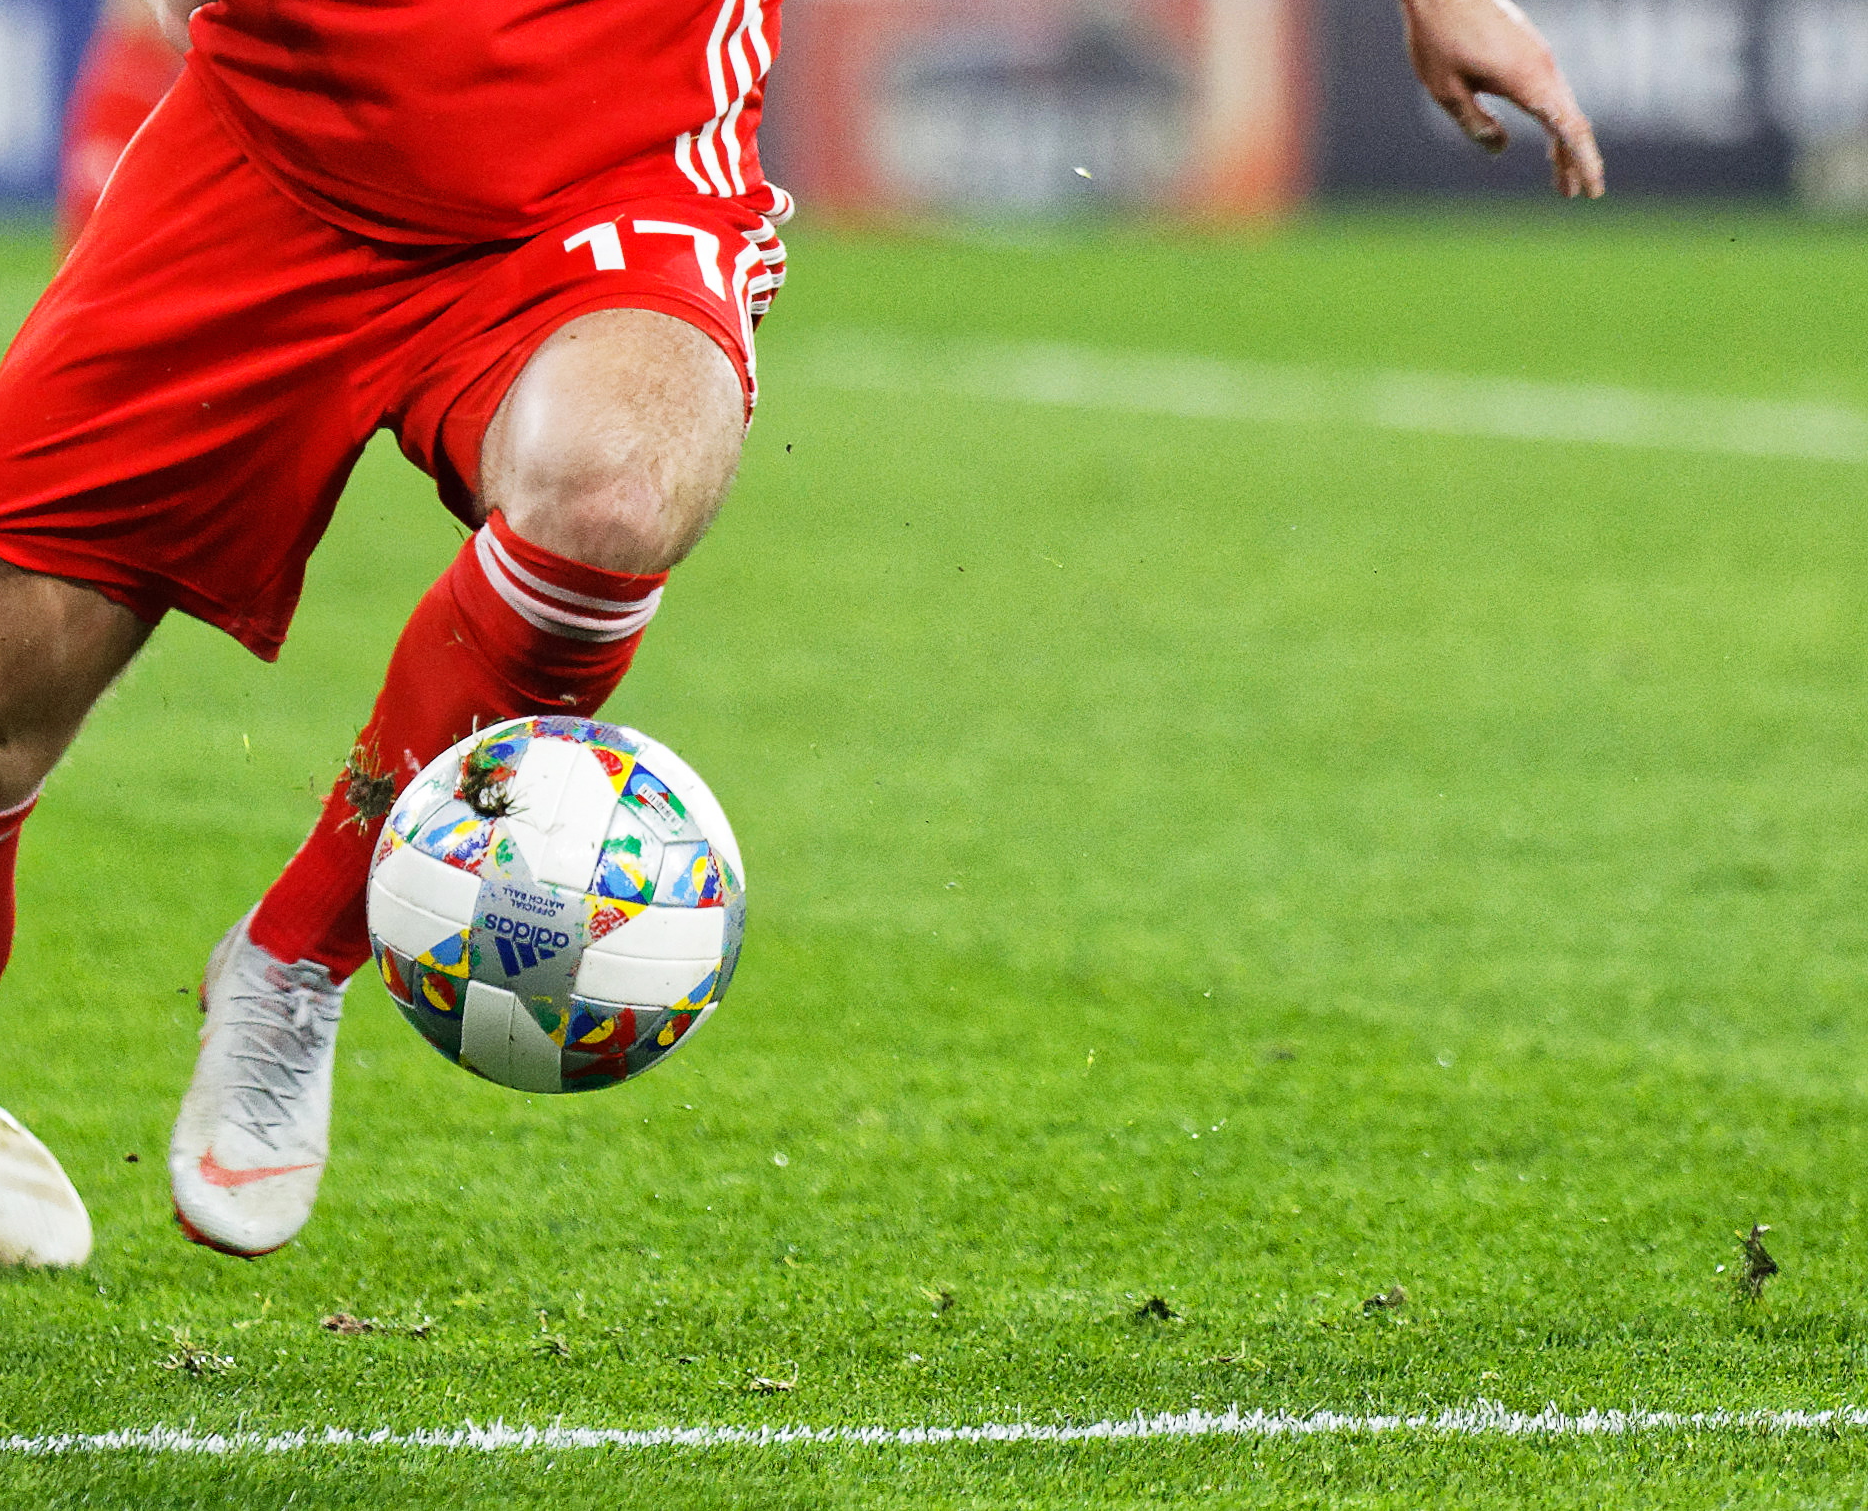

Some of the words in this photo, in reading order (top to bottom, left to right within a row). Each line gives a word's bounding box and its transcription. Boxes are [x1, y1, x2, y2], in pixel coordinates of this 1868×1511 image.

[563, 218, 727, 302] 17
[502, 886, 528, 902] BALL
[529, 894, 565, 910] MATCH
[510, 898, 556, 918] OFFICIAL
[484, 913, 570, 949] adidas
